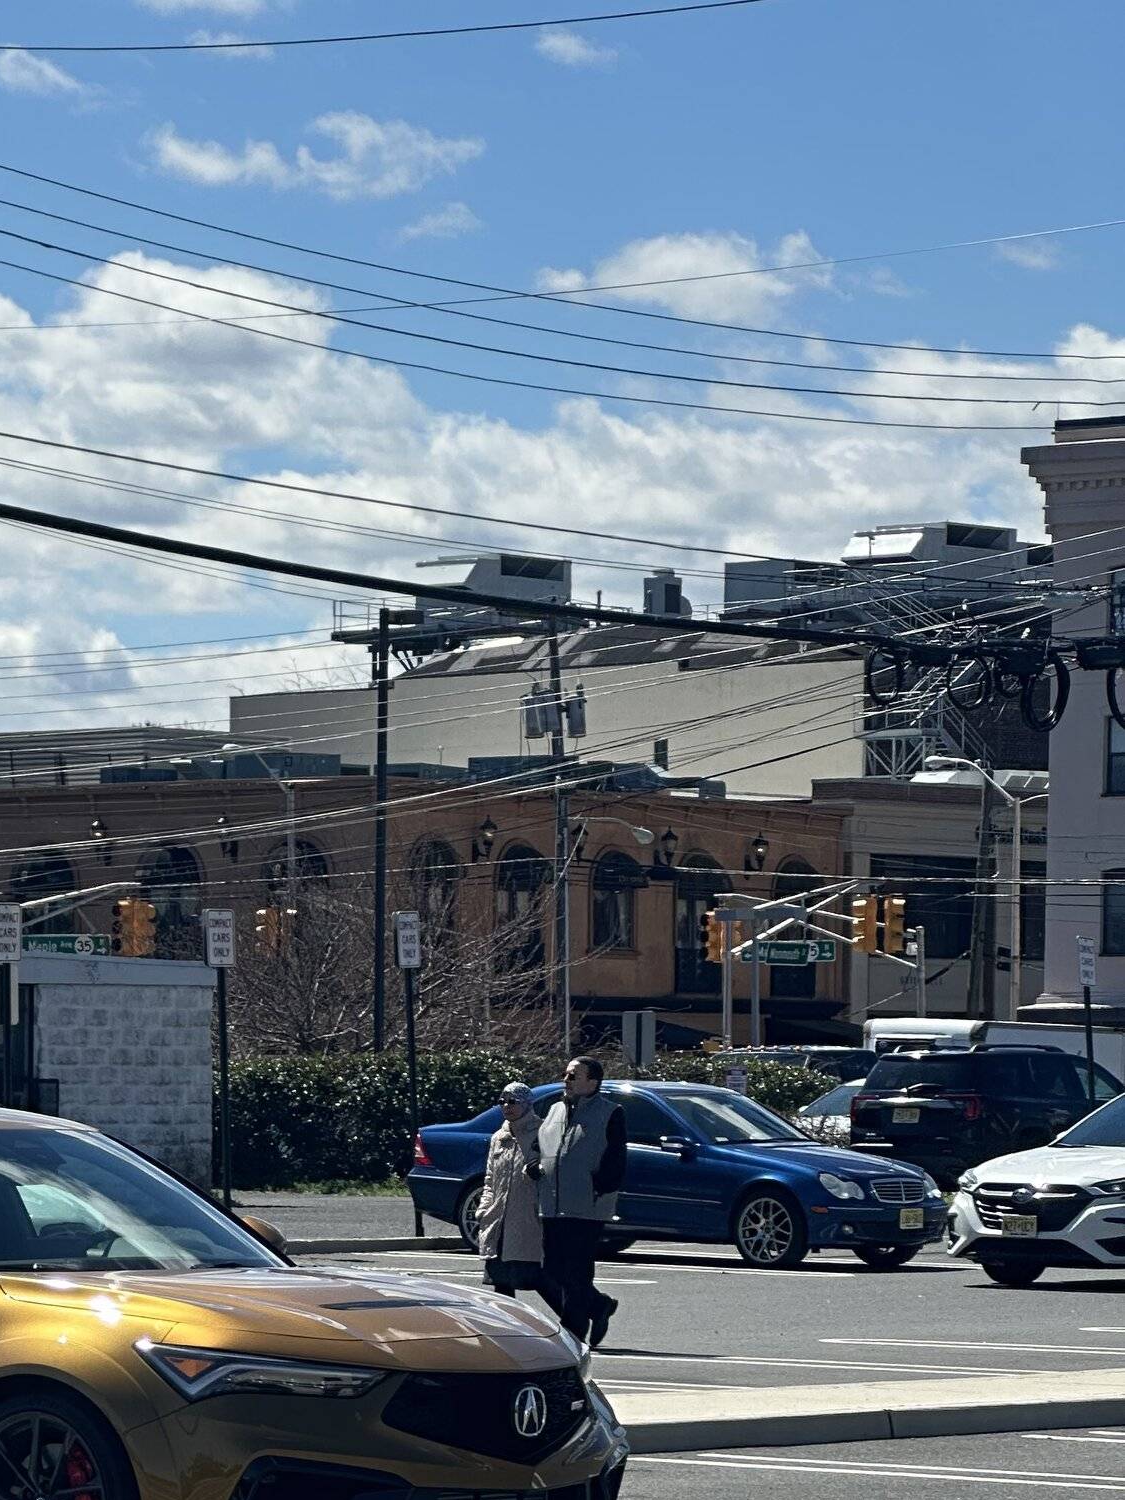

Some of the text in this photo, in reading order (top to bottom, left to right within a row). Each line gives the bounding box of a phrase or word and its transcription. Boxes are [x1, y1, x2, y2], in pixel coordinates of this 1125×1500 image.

[212, 932, 231, 943] CARS
[401, 934, 417, 944] CARS
[0, 942, 17, 953] ONLY
[28, 941, 57, 953] Maple
[76, 940, 92, 953] 35
[213, 947, 231, 958] ONLY
